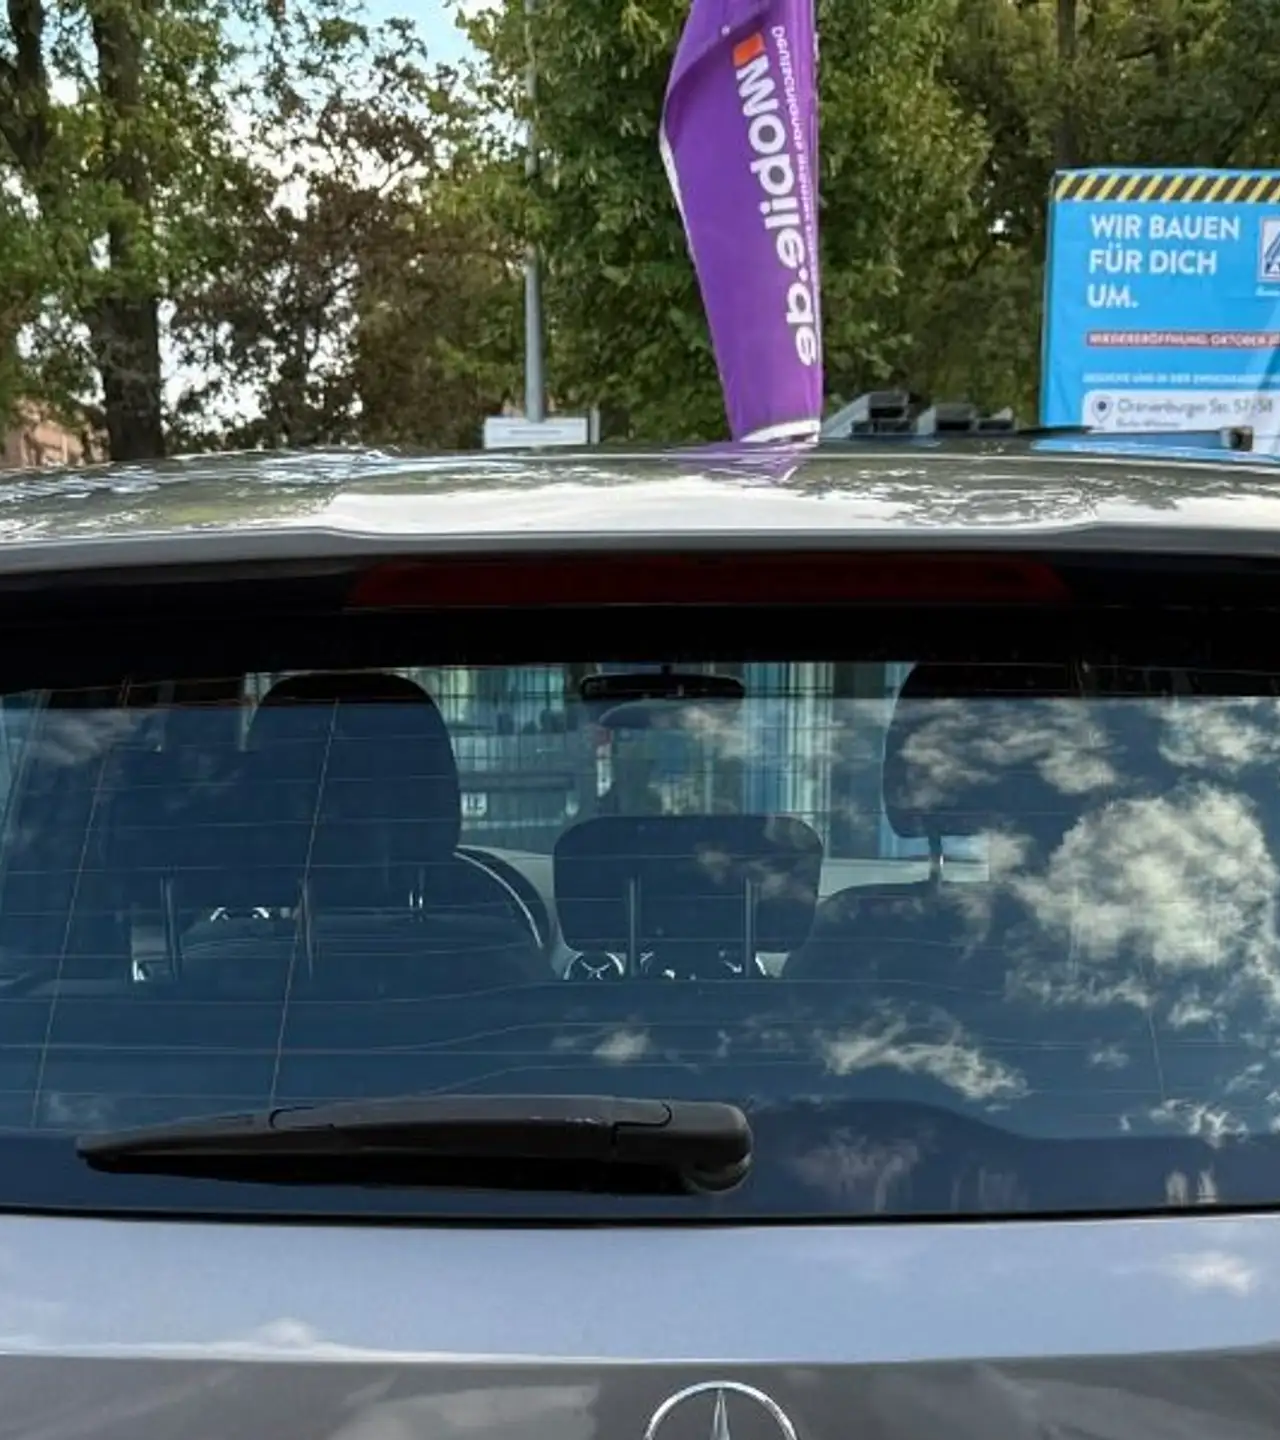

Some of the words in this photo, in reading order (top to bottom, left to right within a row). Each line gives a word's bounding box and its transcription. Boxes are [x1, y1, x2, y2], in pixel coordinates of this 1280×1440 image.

[1090, 214, 1141, 239] WIR
[1149, 214, 1240, 240] BAUEN
[1089, 241, 1141, 274] FÜR
[1150, 250, 1217, 275] DICH
[1087, 284, 1139, 309] UM.
